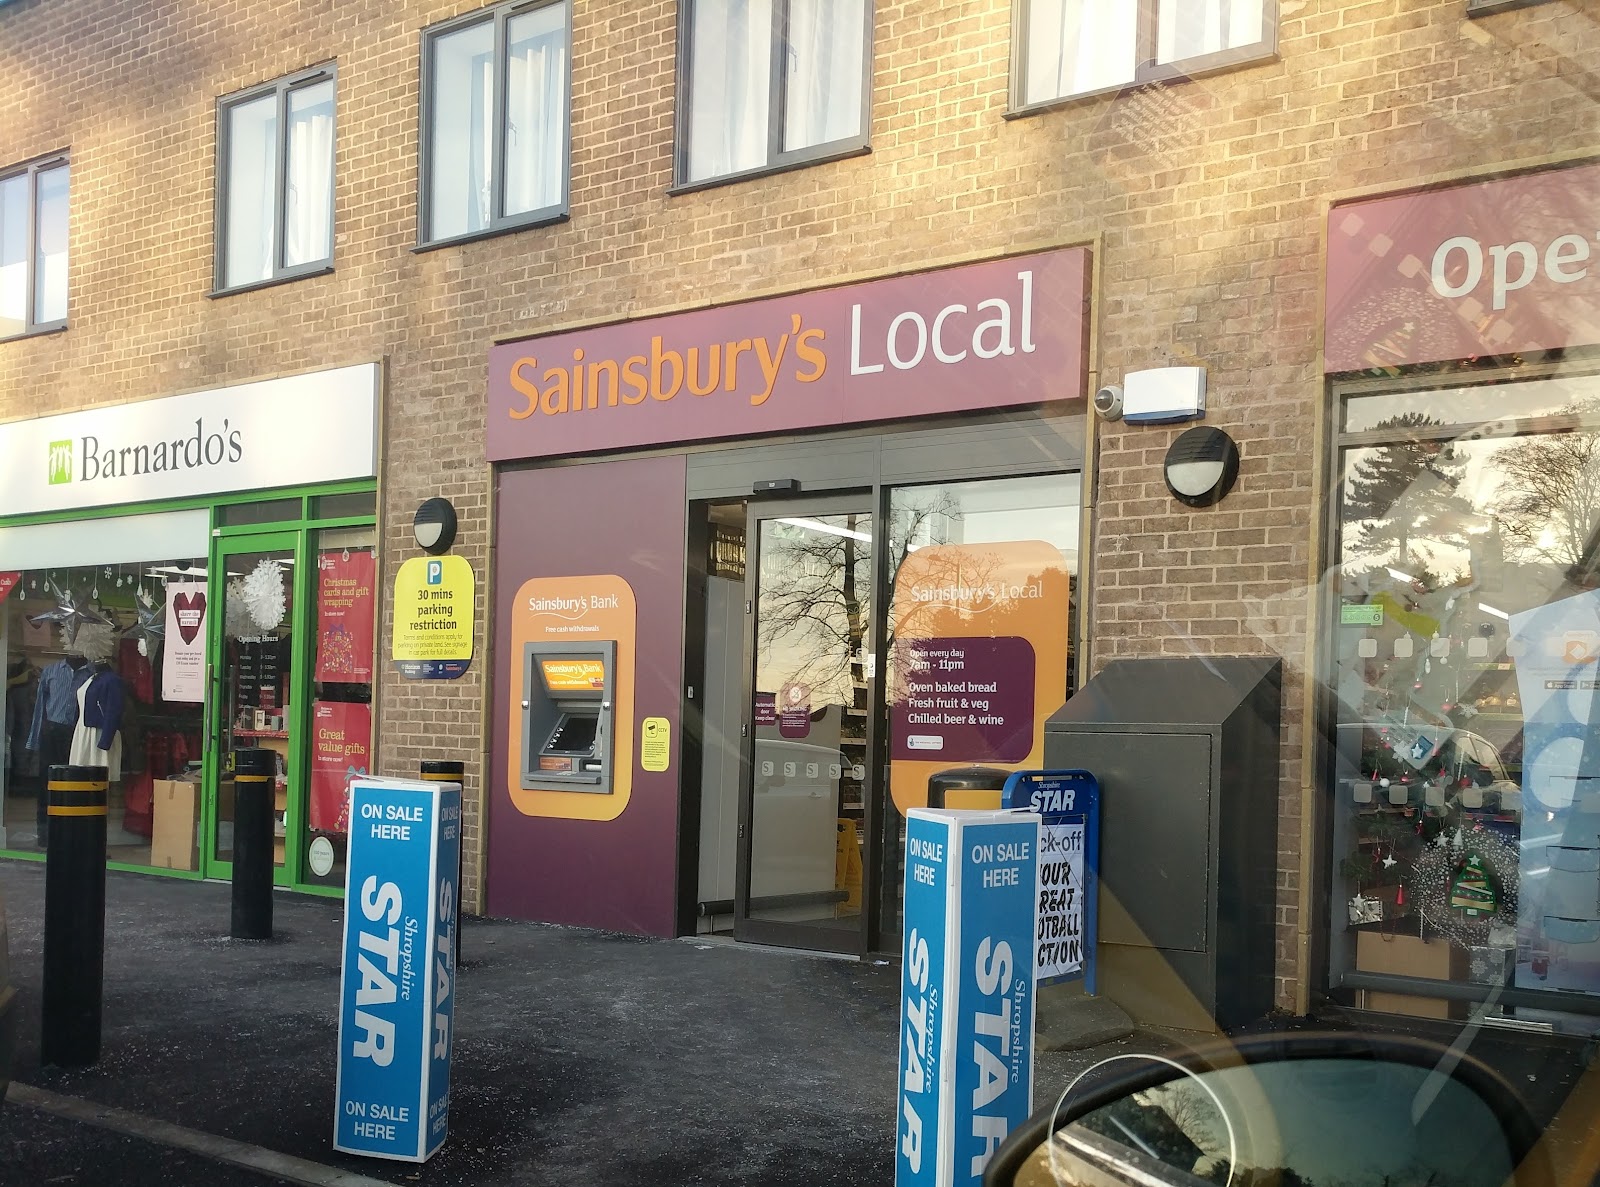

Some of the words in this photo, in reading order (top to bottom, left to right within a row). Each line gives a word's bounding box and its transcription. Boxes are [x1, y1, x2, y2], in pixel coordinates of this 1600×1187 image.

[1431, 234, 1600, 310] Ope
[508, 313, 827, 421] Sainsbury's
[850, 270, 1036, 376] Local
[80, 417, 243, 482] Barnardo's
[324, 578, 357, 587] Christmas
[324, 588, 340, 597] cards
[342, 587, 355, 596] and
[355, 586, 369, 598] gift
[911, 581, 995, 604] Sainsbury's
[1002, 581, 1043, 599] Local
[324, 598, 353, 608] wrapping
[417, 589, 429, 600] 30
[431, 588, 453, 600] mins
[529, 595, 587, 613] Sainsbury's
[591, 594, 619, 609] Bank
[417, 604, 453, 618] parking
[409, 618, 457, 631] restriction
[545, 625, 556, 633] Free
[557, 625, 568, 633] cash
[569, 625, 600, 633] withdrawals
[238, 635, 261, 643] Opening
[910, 650, 928, 658] Open
[929, 650, 949, 659] every
[950, 650, 964, 658] day
[545, 664, 582, 674] Sainsbury's
[583, 664, 601, 673] Bank
[909, 660, 930, 670] 7am
[939, 660, 964, 672] 11pm
[909, 682, 933, 693] Oven
[935, 682, 965, 693] baked
[968, 682, 997, 693] bread
[908, 698, 934, 709] Fresh
[936, 698, 959, 709] fruit
[960, 699, 969, 709] &
[971, 700, 989, 712] veg
[908, 713, 942, 724] Chilled
[944, 714, 967, 725] beer
[969, 715, 977, 725] &
[979, 715, 1004, 726] wine
[319, 728, 345, 741] Great
[318, 741, 343, 753] value
[345, 743, 365, 756] gifts
[1030, 790, 1076, 813] STAR
[361, 803, 382, 819] ON
[385, 805, 423, 822] SALE
[371, 824, 411, 841] HERE
[1040, 830, 1082, 853] ck-off
[910, 838, 921, 855] ON
[922, 841, 943, 863] SALE
[972, 845, 993, 864] ON
[997, 843, 1029, 862] SALE
[914, 863, 935, 886] HERE
[983, 867, 1019, 888] HERE
[1039, 862, 1071, 886] OUR
[1039, 888, 1074, 914] REAT
[1037, 913, 1079, 940] OTBALL
[400, 915, 418, 1001] Shropshire
[1037, 940, 1079, 967] CTION
[352, 875, 403, 1067] STAR
[434, 877, 452, 1061] STAR
[925, 984, 938, 1094] Shropshire
[1010, 978, 1026, 1084] Shropshire
[902, 928, 929, 1175] STAR
[345, 1100, 366, 1117] ON
[370, 1103, 409, 1122] SALE
[353, 1122, 396, 1141] HERE
